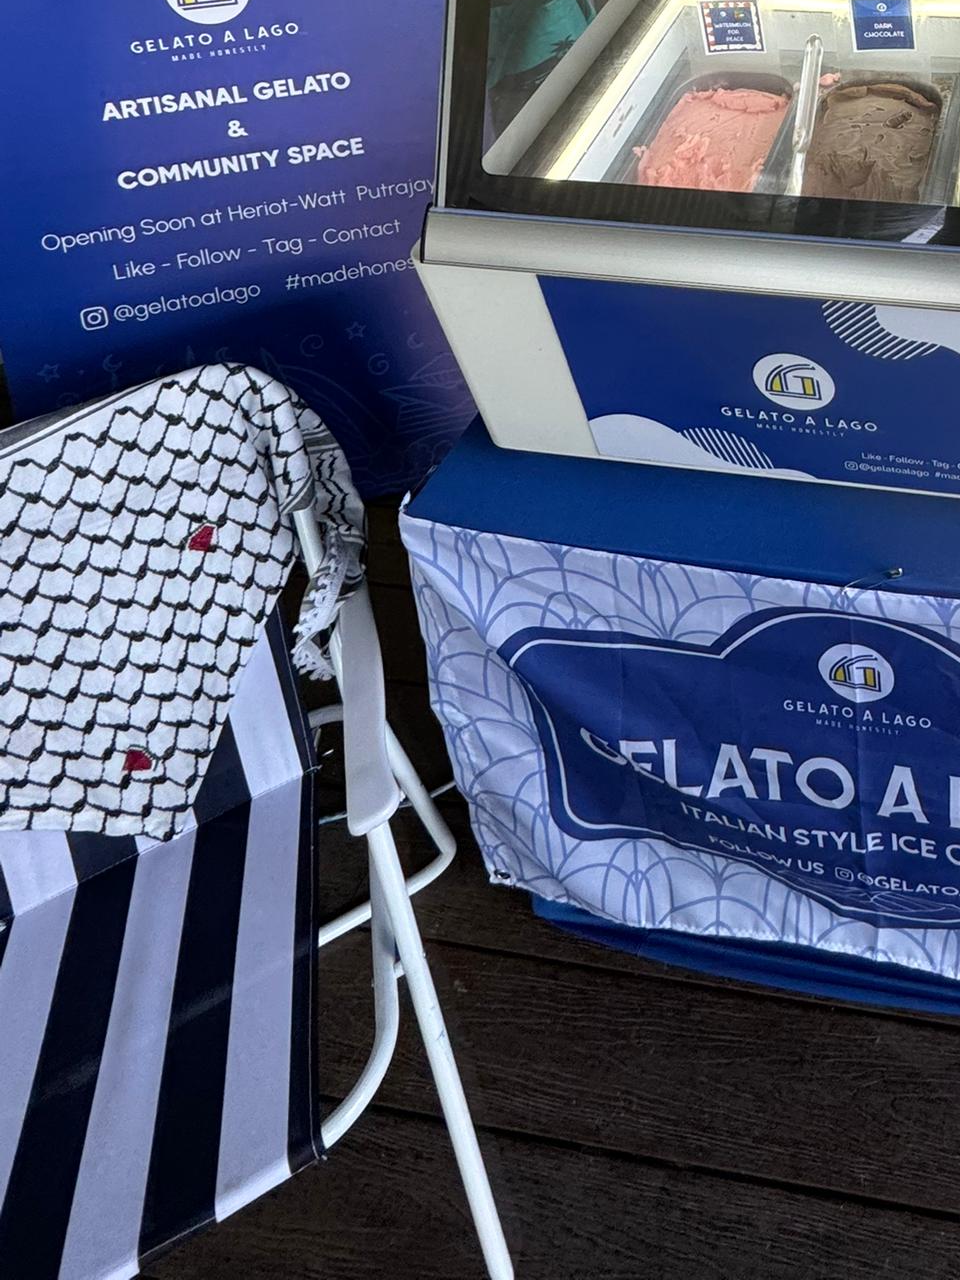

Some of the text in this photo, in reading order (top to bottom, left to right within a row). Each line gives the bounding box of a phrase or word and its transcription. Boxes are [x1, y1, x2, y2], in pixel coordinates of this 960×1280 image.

[130, 22, 299, 55] GELATO A LAGO
[863, 30, 905, 38] CHOCOLATE
[102, 72, 351, 121] ARTISANAL GELATO
[227, 120, 248, 138] &
[117, 137, 365, 190] COMMUNITY SPACE
[41, 225, 136, 254] Opening
[140, 216, 196, 235] Soon
[200, 208, 222, 226] at
[227, 189, 346, 222] Heriot-Watt
[112, 260, 156, 280] Like
[176, 247, 241, 269] Follow
[262, 237, 303, 255] Tag
[322, 219, 401, 245] Contact
[113, 284, 261, 322] @gelatoalago
[720, 406, 878, 432] GELATO A LAGO
[859, 462, 930, 478] @gelatoalago
[861, 452, 882, 461] Like
[889, 454, 924, 466] Follow
[931, 459, 950, 470] Tag
[783, 699, 932, 729] GELATO A LAGO
[876, 764, 930, 824] A
[681, 801, 788, 843] ITALIAN
[792, 828, 884, 854] STYLE
[891, 832, 938, 860] ICE
[797, 859, 824, 875] US
